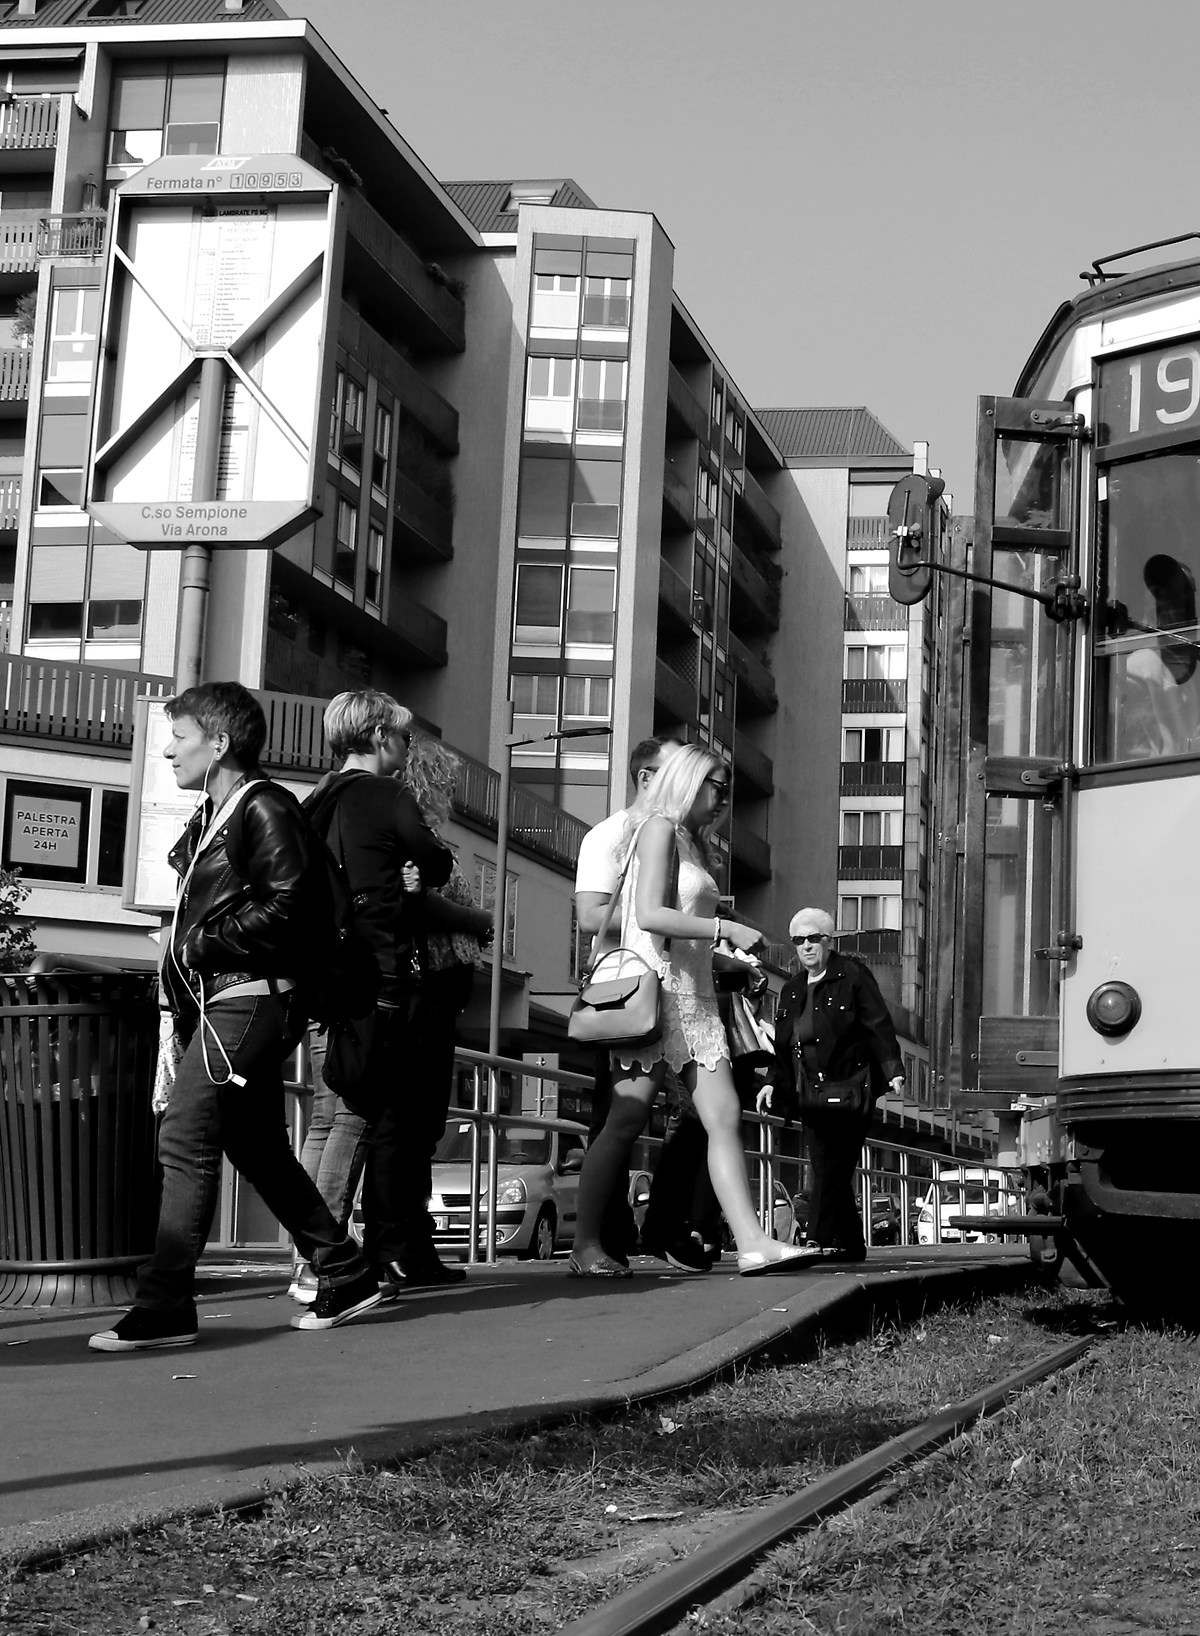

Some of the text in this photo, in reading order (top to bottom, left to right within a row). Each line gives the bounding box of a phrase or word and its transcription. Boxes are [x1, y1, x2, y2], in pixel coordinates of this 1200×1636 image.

[147, 178, 203, 189] Fermata
[232, 174, 301, 187] 10953
[141, 506, 247, 520] C.so Sempione
[161, 524, 228, 536] Via Arona
[17, 811, 76, 825] PALESTRA
[23, 826, 69, 838] APERTA
[33, 840, 57, 850] 24H
